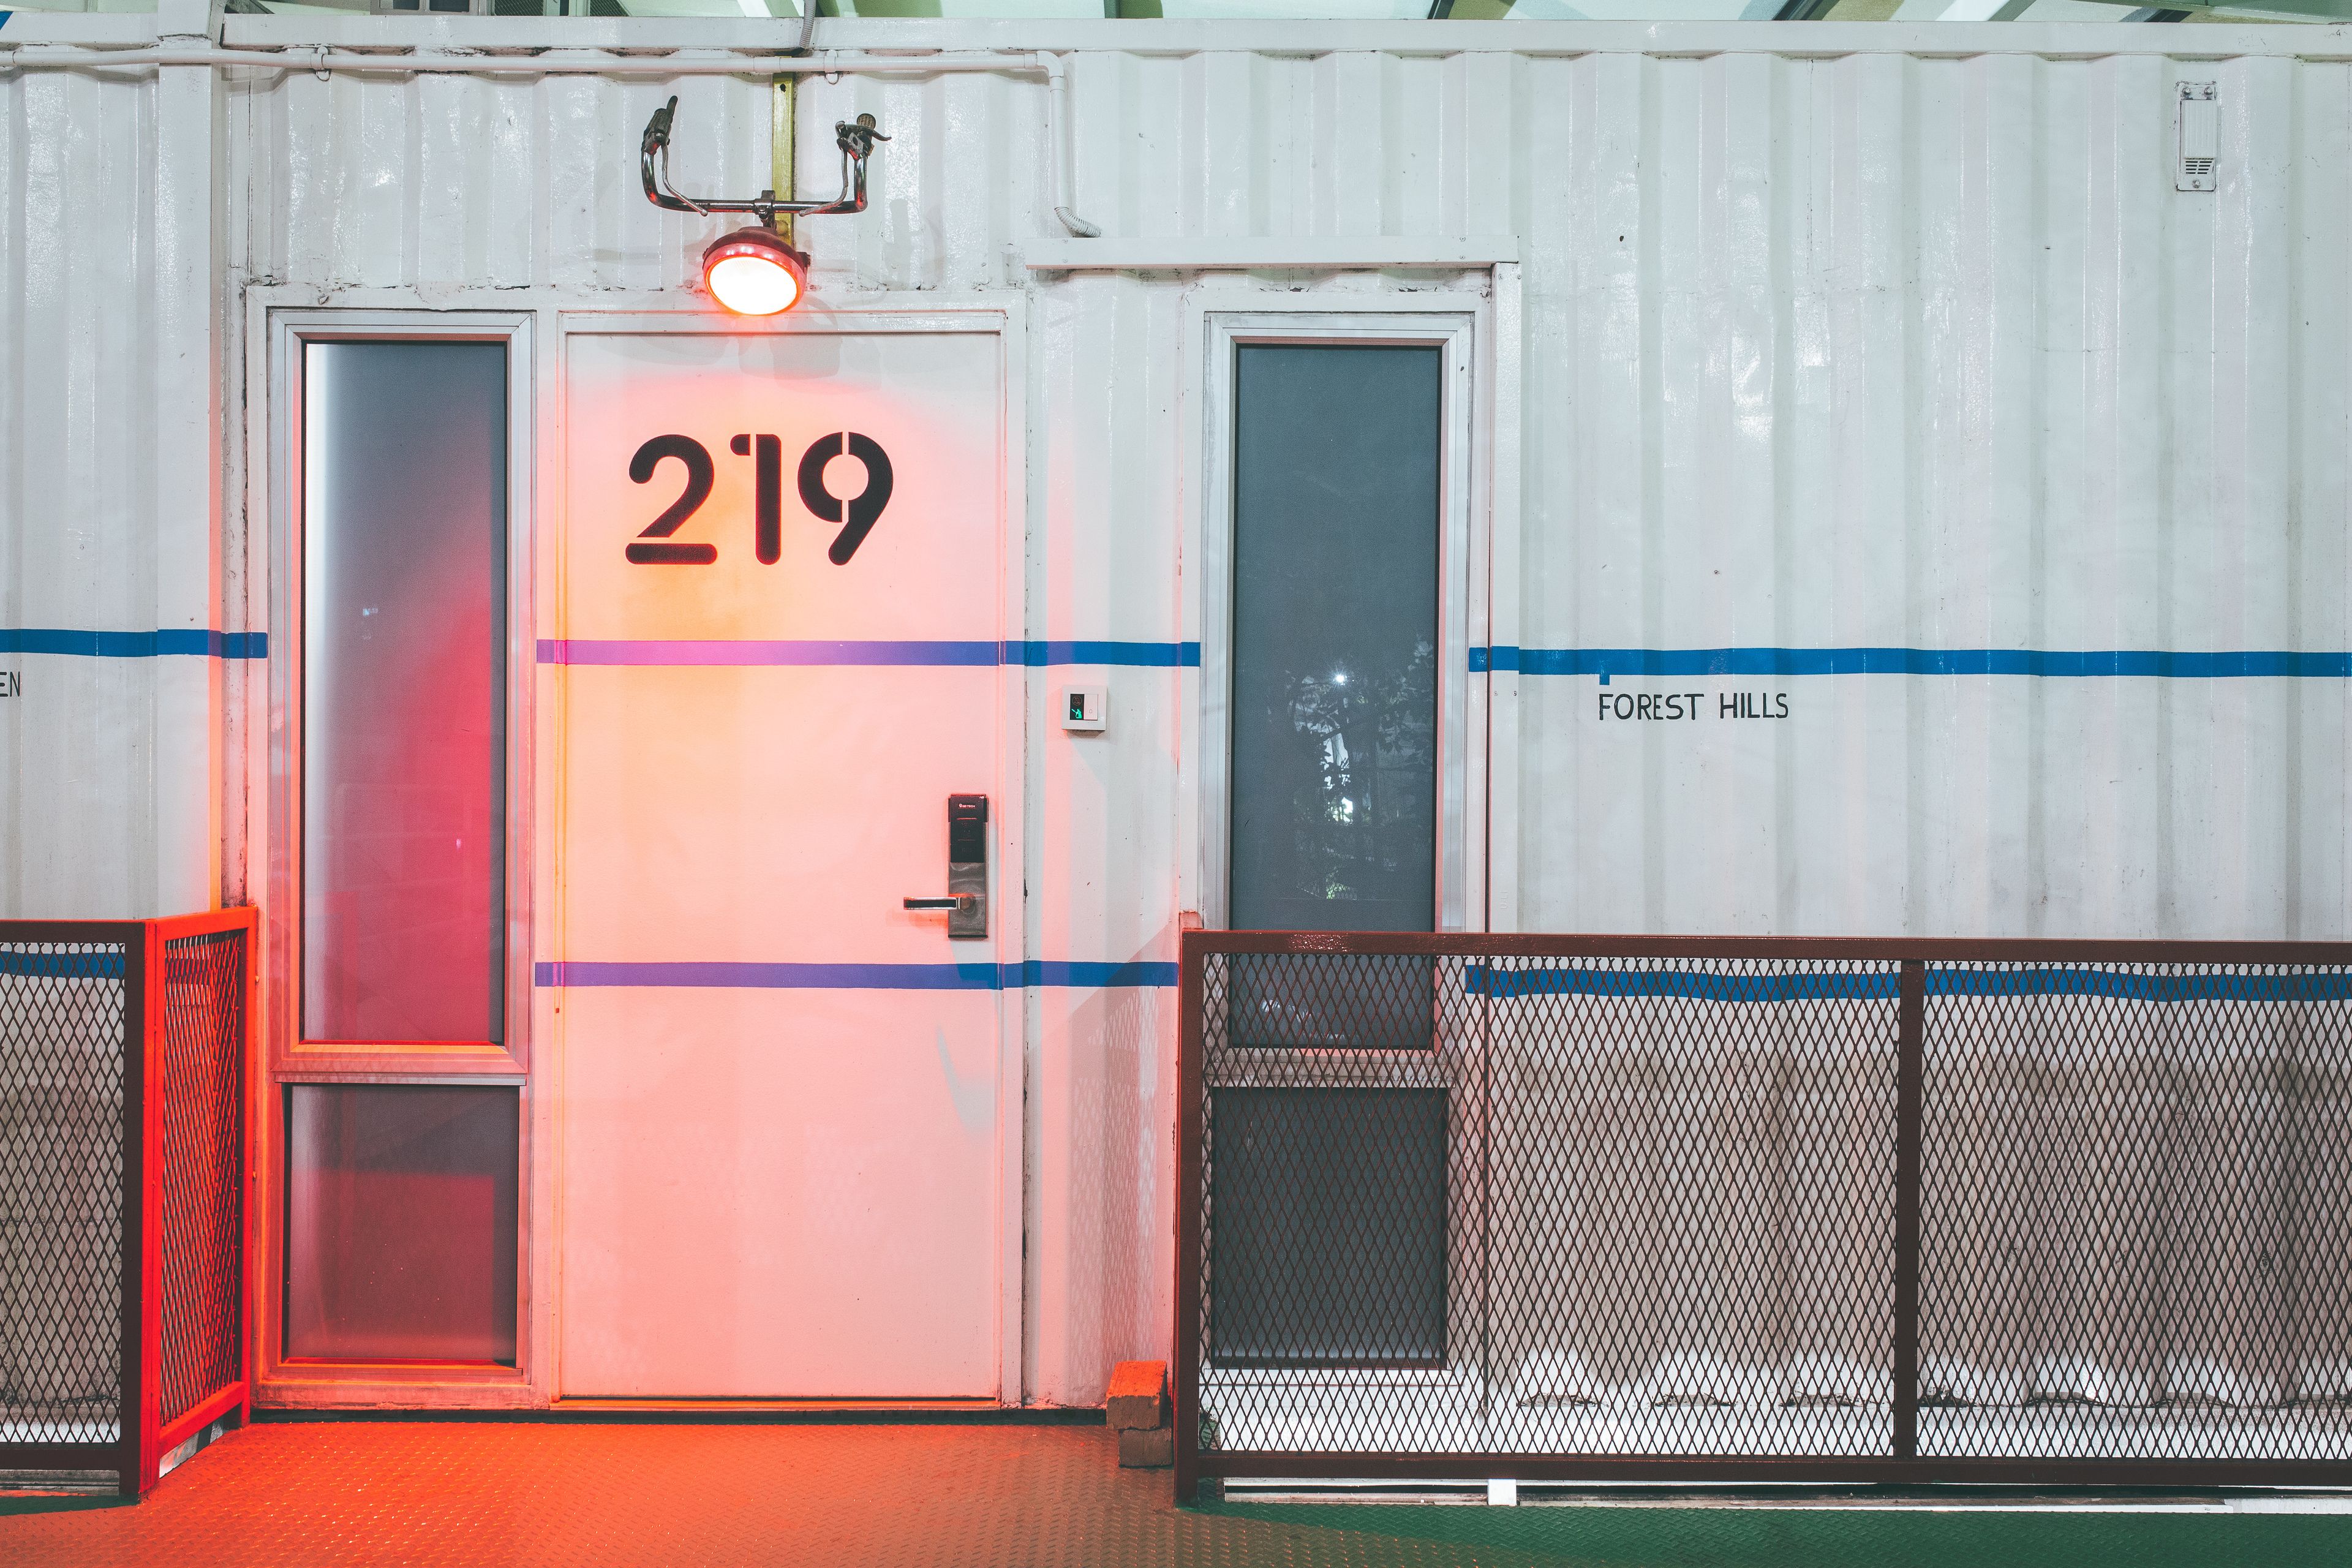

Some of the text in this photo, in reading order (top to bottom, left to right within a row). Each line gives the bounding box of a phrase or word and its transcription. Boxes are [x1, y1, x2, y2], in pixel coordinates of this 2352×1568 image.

[625, 431, 894, 566] 219
[1599, 692, 1789, 721] FOREST HILLS
